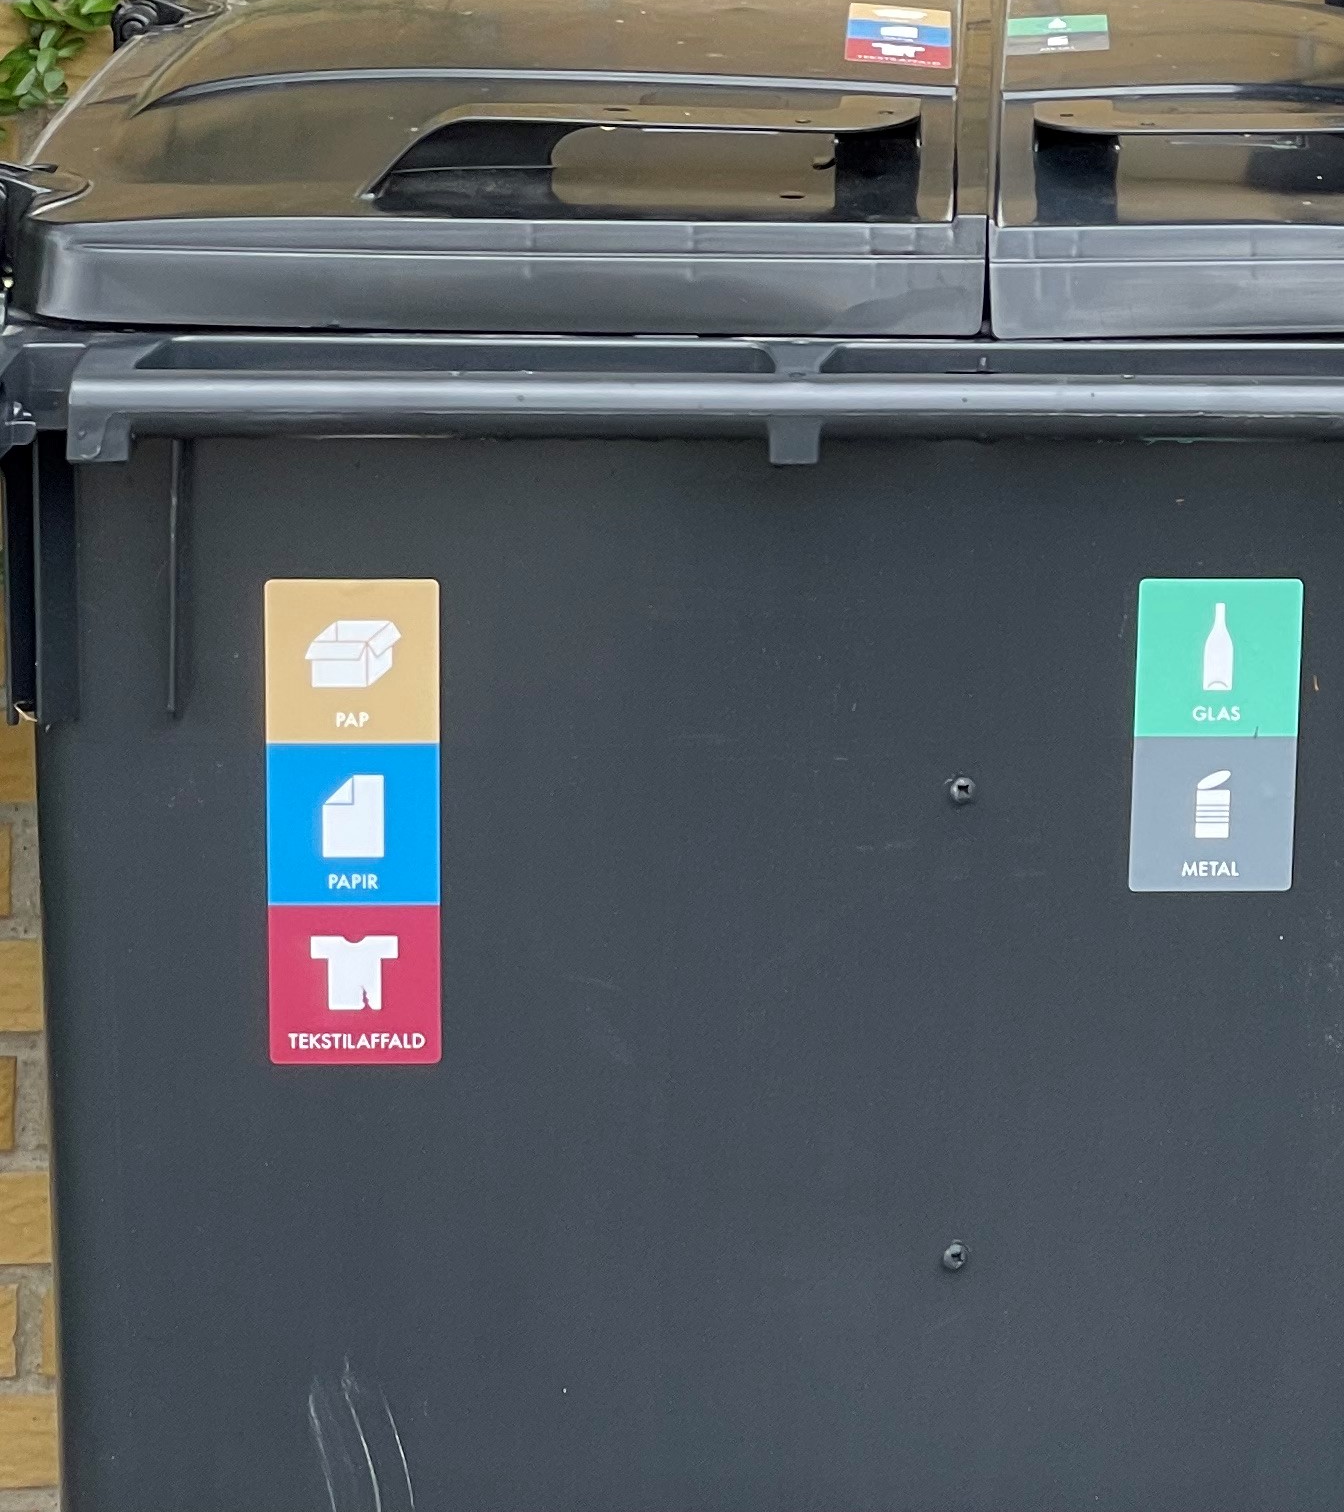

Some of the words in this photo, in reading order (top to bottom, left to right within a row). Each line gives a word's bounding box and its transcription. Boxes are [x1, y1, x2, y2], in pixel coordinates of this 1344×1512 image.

[336, 711, 369, 728] PAP
[1192, 705, 1241, 722] GLAS
[1181, 860, 1240, 877] METAL
[328, 873, 379, 890] PAPIR
[288, 1032, 426, 1050] TEKSTILAFFALD
